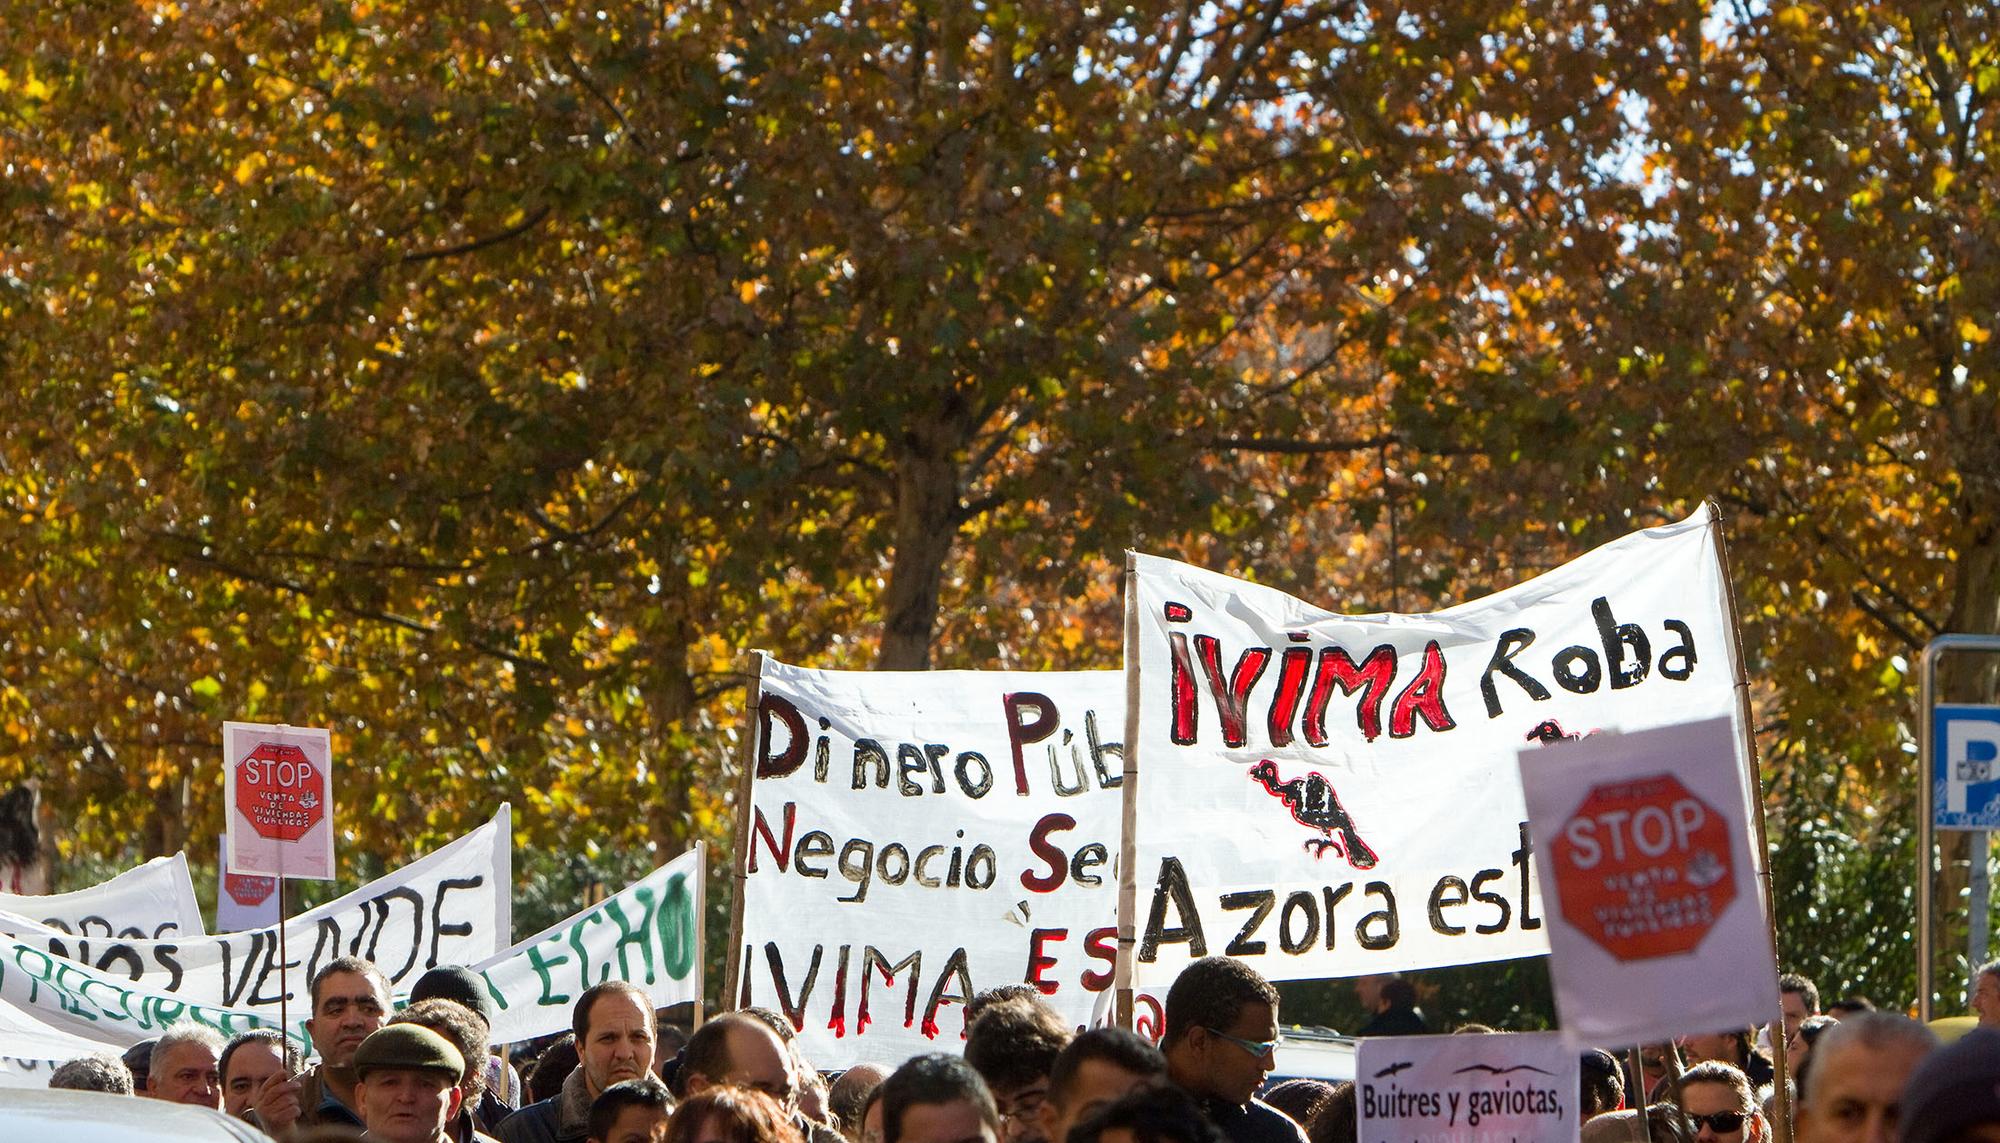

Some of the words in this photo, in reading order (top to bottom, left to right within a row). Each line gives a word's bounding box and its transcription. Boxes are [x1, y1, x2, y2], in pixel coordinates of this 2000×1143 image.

[1480, 597, 1697, 718] Roba
[245, 758, 312, 789] STOP
[756, 690, 994, 799] Dinero
[1003, 691, 1124, 797] Púb
[1946, 719, 2000, 812] P
[259, 791, 295, 802] VENTA
[270, 801, 283, 809] DE
[1566, 800, 1704, 870] STOP
[749, 802, 996, 903] Negocio
[1020, 813, 1118, 893] Se
[1138, 857, 1400, 963] Azora
[1427, 822, 1542, 936] est
[739, 941, 975, 1040] IVIMA
[1363, 1082, 1441, 1119] Buitres
[1448, 1090, 1461, 1127] y
[1467, 1079, 1564, 1127] gaviotas,
